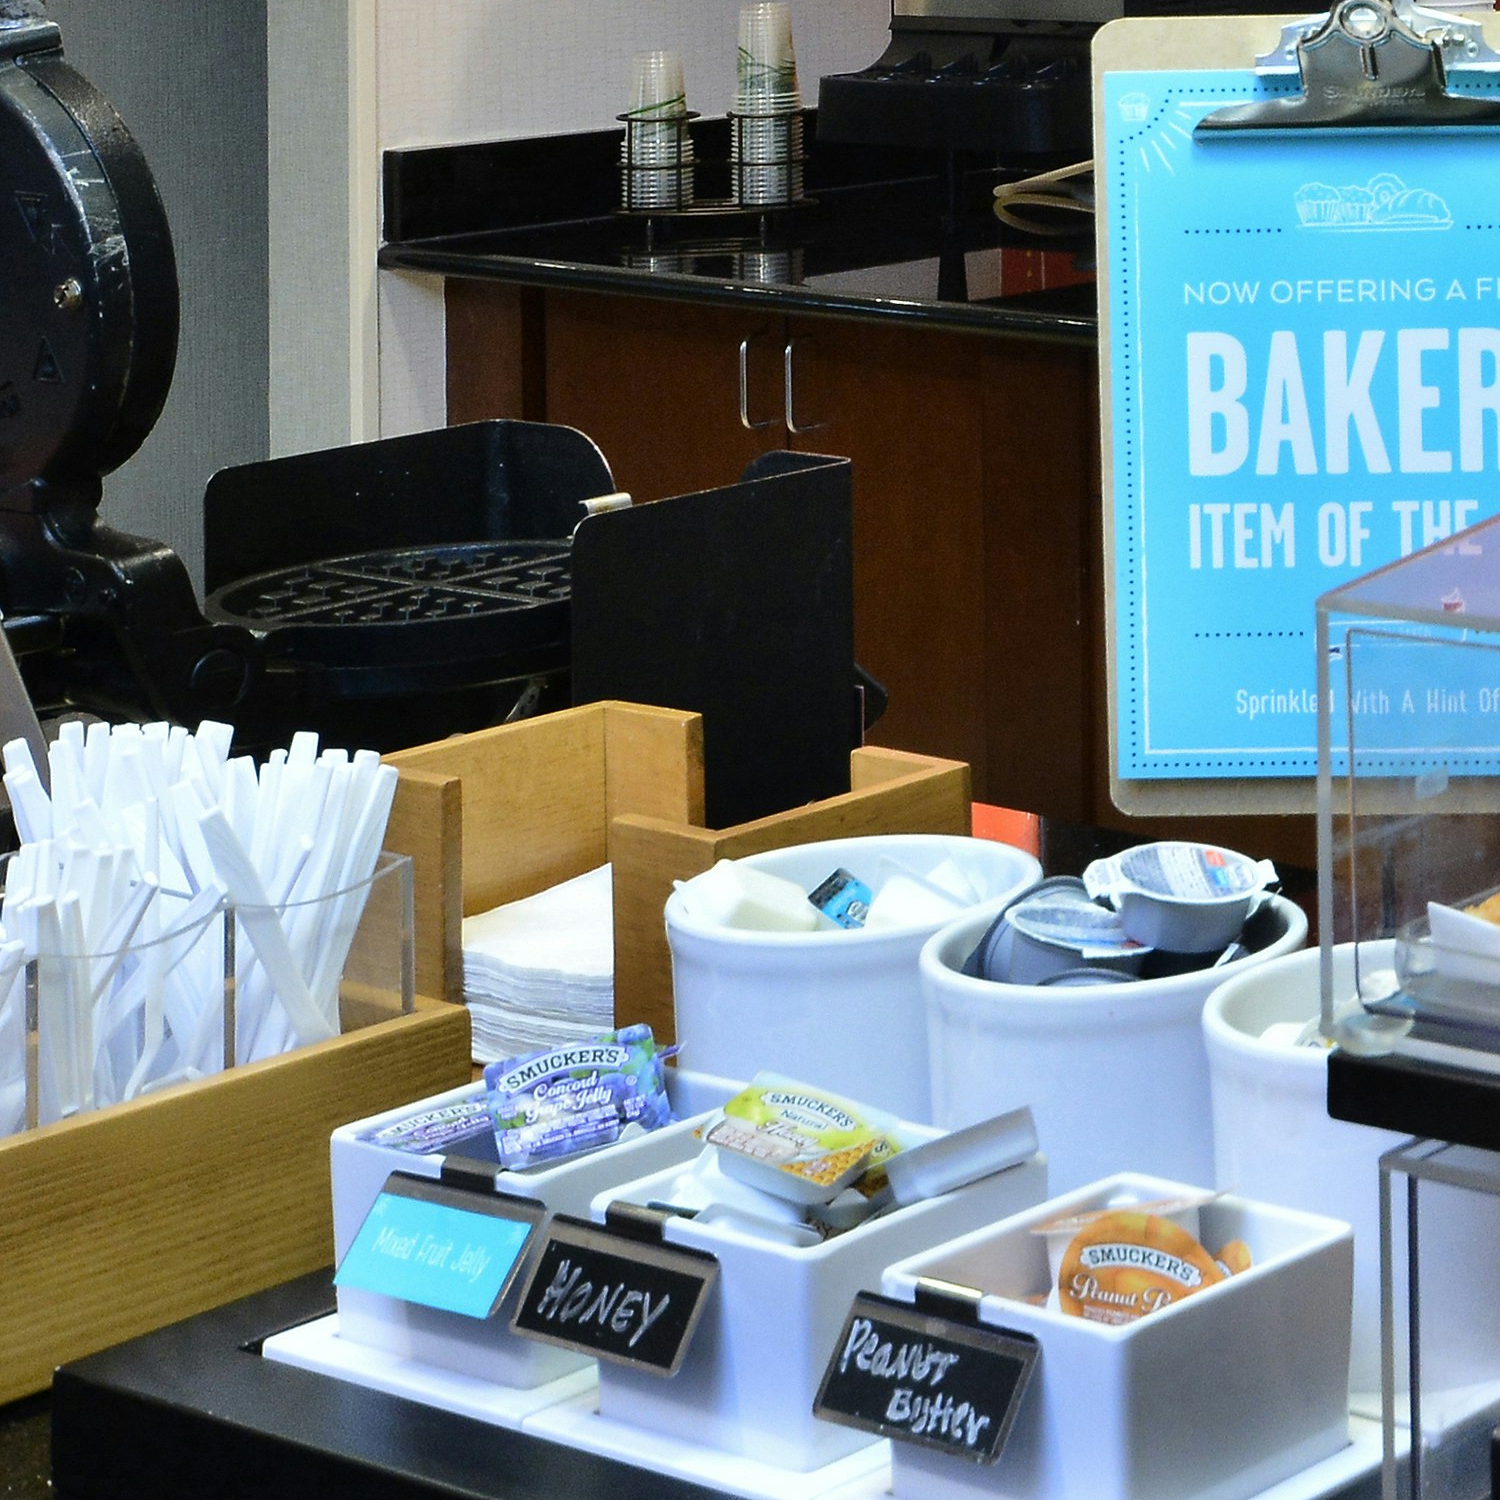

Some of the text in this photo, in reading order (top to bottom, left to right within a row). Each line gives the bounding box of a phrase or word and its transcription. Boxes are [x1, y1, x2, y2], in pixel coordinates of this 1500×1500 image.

[1183, 280, 1259, 306] NOW
[1270, 277, 1436, 305] OFFERING
[1446, 278, 1468, 302] A
[1189, 502, 1296, 569] ITEM
[1318, 501, 1373, 568] OF
[1391, 500, 1483, 556] THE
[1402, 687, 1415, 713] A
[1427, 688, 1467, 713] Hint
[1479, 687, 1500, 713] Of
[506, 1048, 619, 1089] SMUCKER'S
[533, 1070, 598, 1101] Concord
[771, 1093, 854, 1130] SMUCKER'S
[371, 1226, 492, 1284] Mixed Fruit Jelly
[1088, 1248, 1195, 1281] SMUCKER'S
[537, 1259, 671, 1348] HONEY
[1069, 1272, 1138, 1306] Peanut
